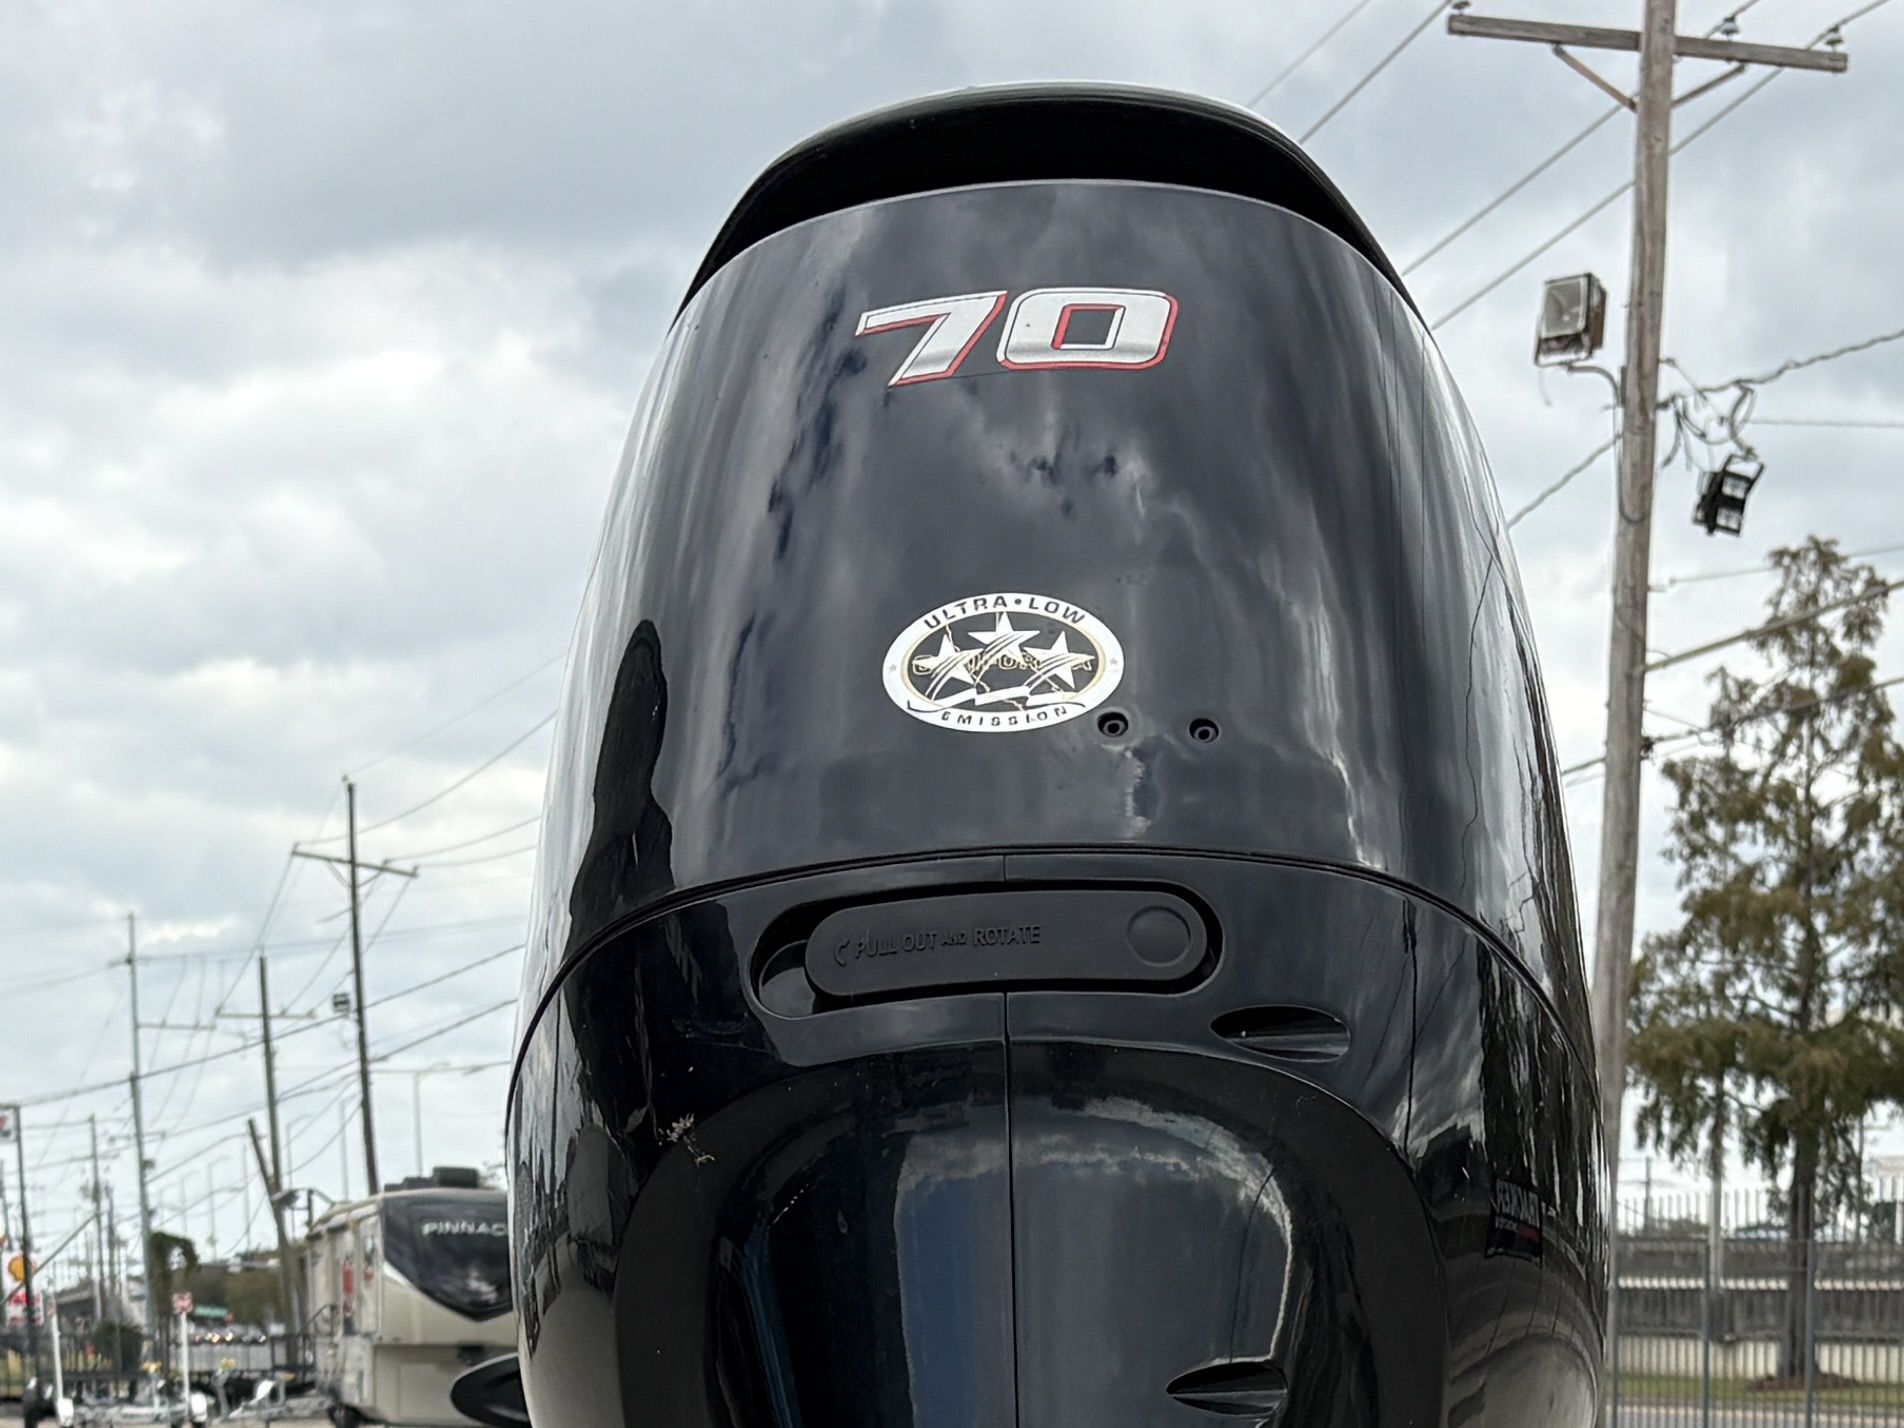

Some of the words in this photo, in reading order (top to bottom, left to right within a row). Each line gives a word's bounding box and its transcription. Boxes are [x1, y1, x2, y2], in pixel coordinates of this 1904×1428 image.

[855, 286, 1178, 388] 70
[924, 595, 1008, 630] ULTRA
[1028, 597, 1086, 625] LOW
[941, 705, 1067, 727] EMISSION
[903, 932, 937, 953] OUT
[973, 925, 1042, 947] ROTATE
[422, 1220, 507, 1238] PINNAC
